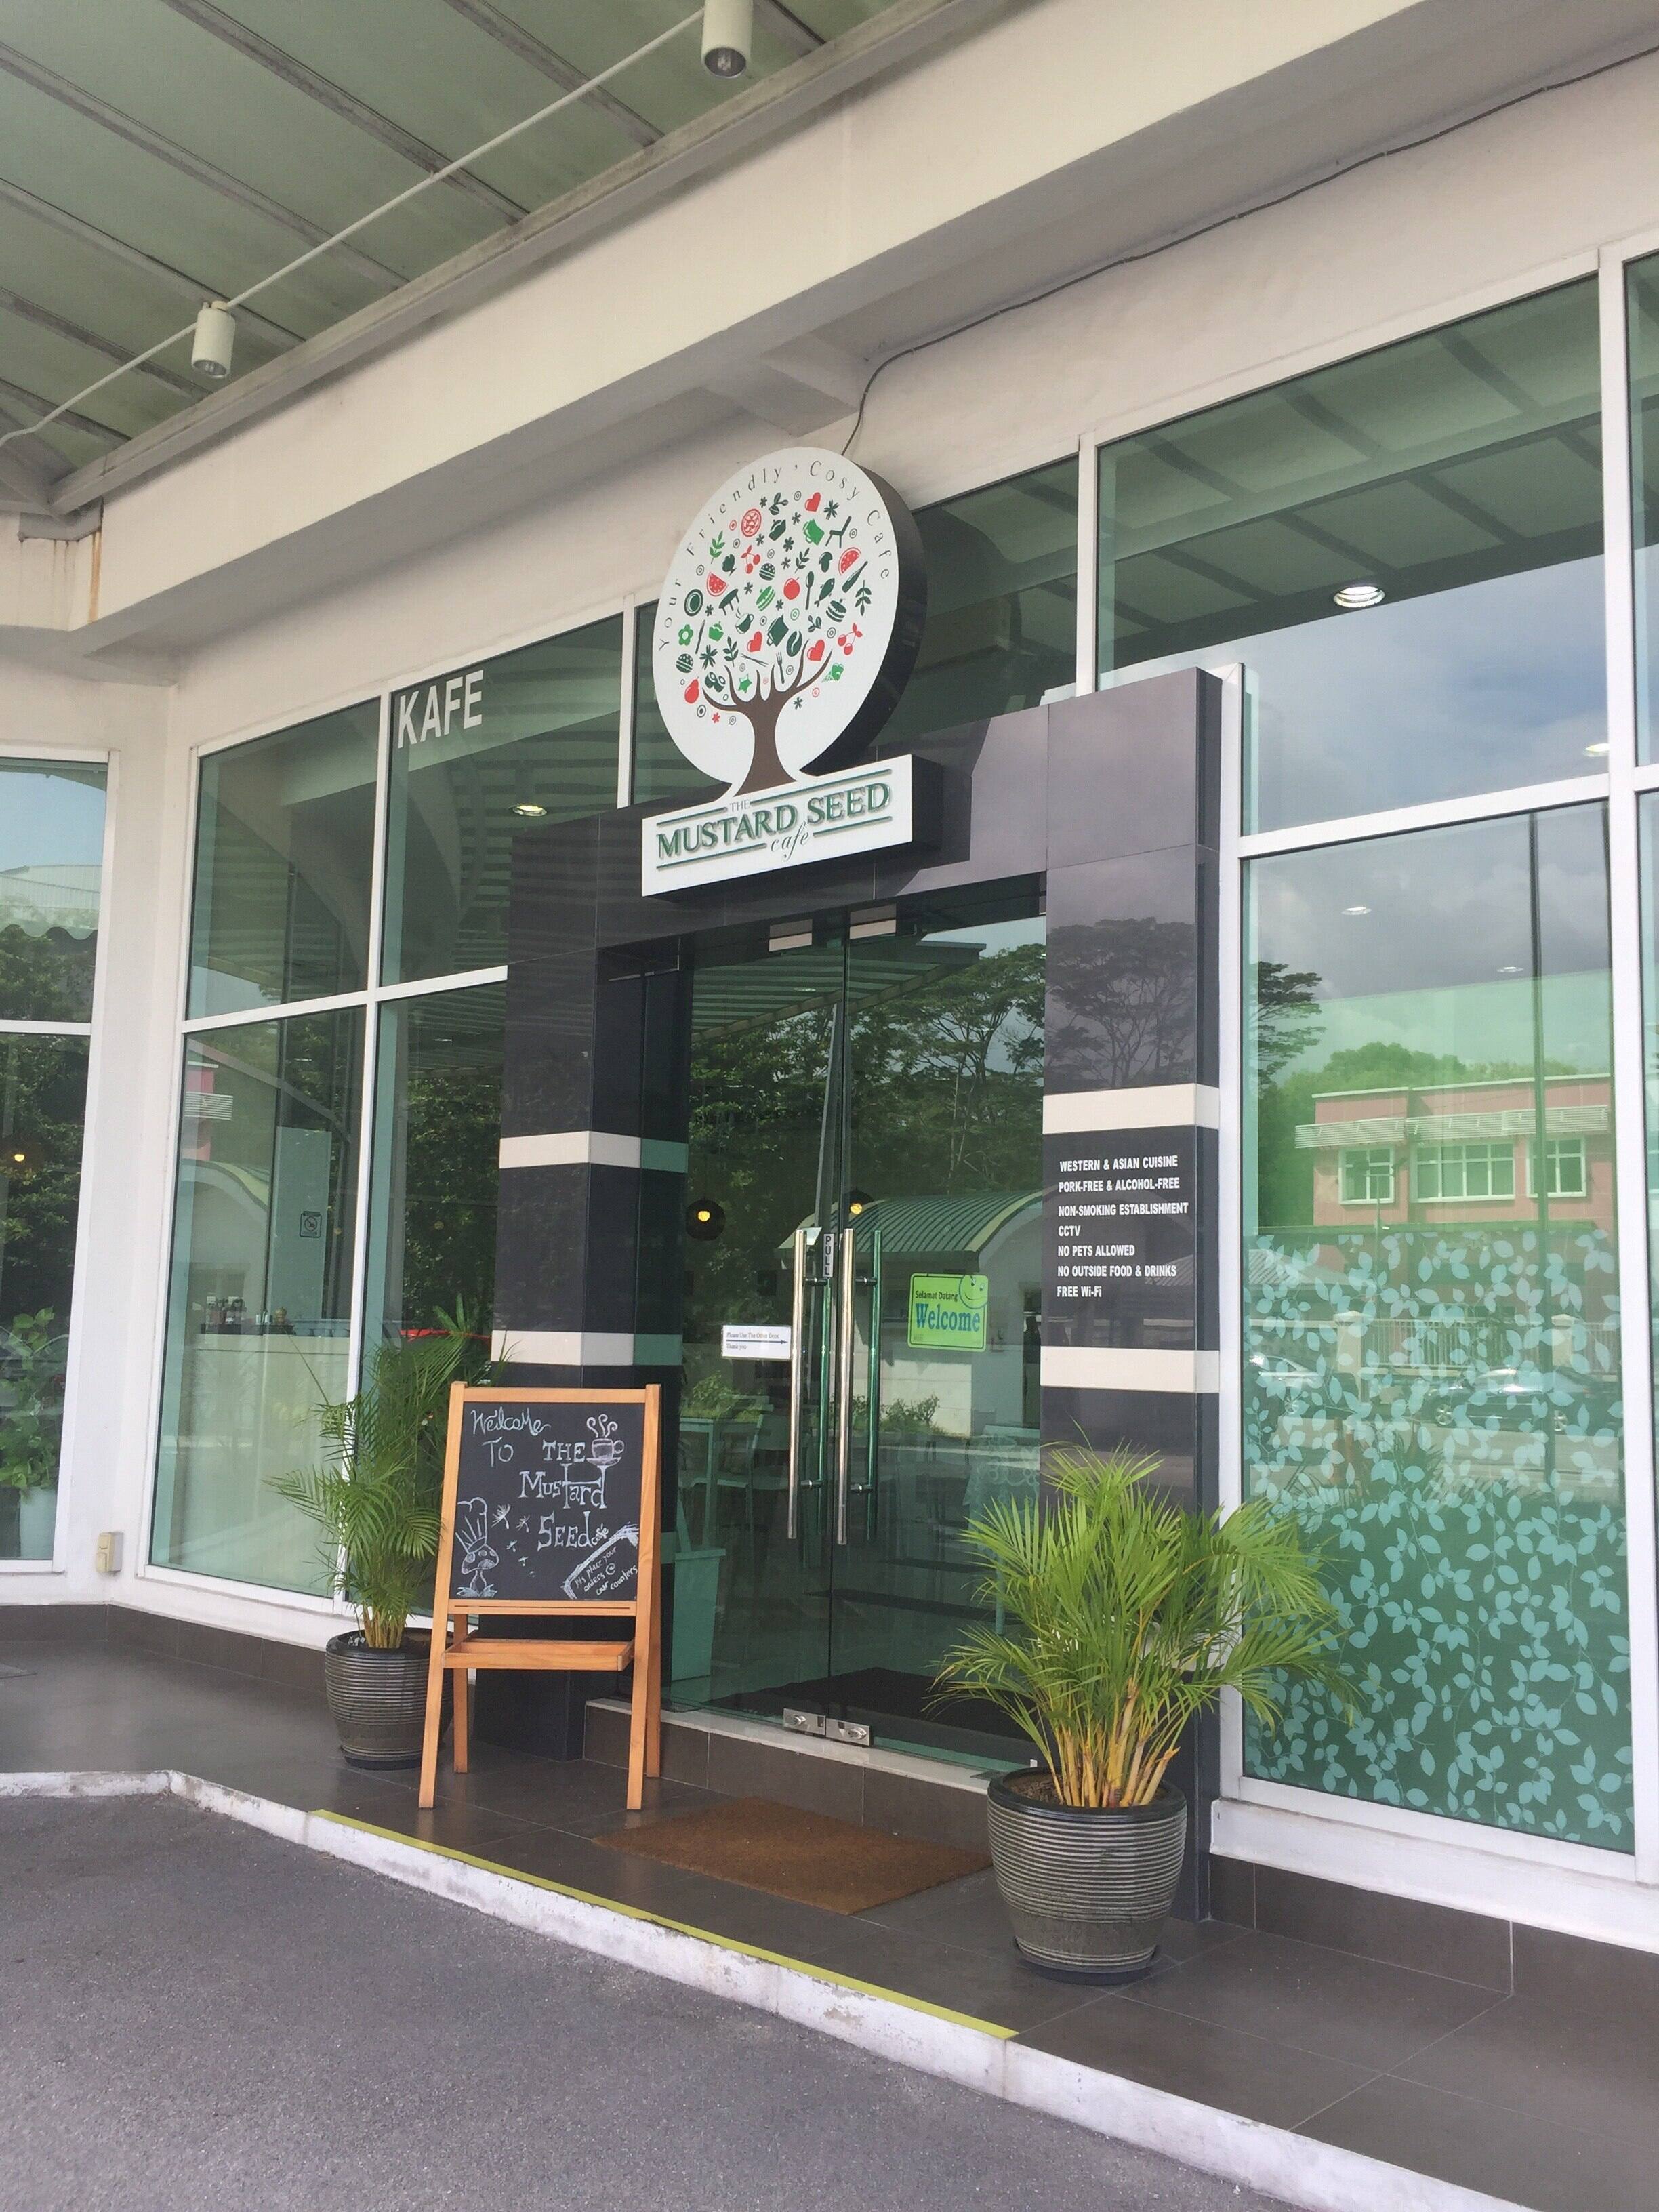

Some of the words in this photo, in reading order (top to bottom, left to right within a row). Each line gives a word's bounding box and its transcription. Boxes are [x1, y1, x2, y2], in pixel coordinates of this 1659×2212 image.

[809, 460, 860, 501] Cosy
[866, 509, 891, 580] Cafe
[398, 670, 484, 749] KAFE
[729, 800, 750, 813] THE
[656, 803, 798, 859] MUSTARD
[806, 782, 890, 825] SEED
[770, 821, 808, 862] cafe
[1060, 1160, 1101, 1172] WESTERN
[1103, 1159, 1110, 1170] &
[1113, 1158, 1140, 1170] ASIAN
[1143, 1155, 1178, 1168] CUISINE
[1059, 1180, 1103, 1193] PORK-FREE
[1107, 1180, 1113, 1191] &
[1115, 1177, 1180, 1191] ALCOHOL-FREE
[1059, 1204, 1117, 1216] NON-SMOKING
[1120, 1202, 1189, 1215] ESTABLISHMENT
[1059, 1225, 1081, 1236] CCTV
[1058, 1246, 1070, 1256] NO
[1072, 1245, 1093, 1256] PETS
[1095, 1244, 1135, 1256] ALLOWED
[1058, 1265, 1070, 1277] NO
[1072, 1265, 1107, 1277] OUTSIDE
[1109, 1265, 1132, 1277] FOOD
[1135, 1265, 1142, 1277] &
[1145, 1265, 1177, 1277] DRINKS
[916, 1290, 937, 1299] Selamat
[939, 1292, 958, 1302] Datang
[1057, 1286, 1078, 1297] FREE
[1081, 1286, 1102, 1297] Wi-Fi
[916, 1303, 981, 1332] Welcome
[542, 1439, 586, 1462] THE
[605, 1563, 615, 1575] @
